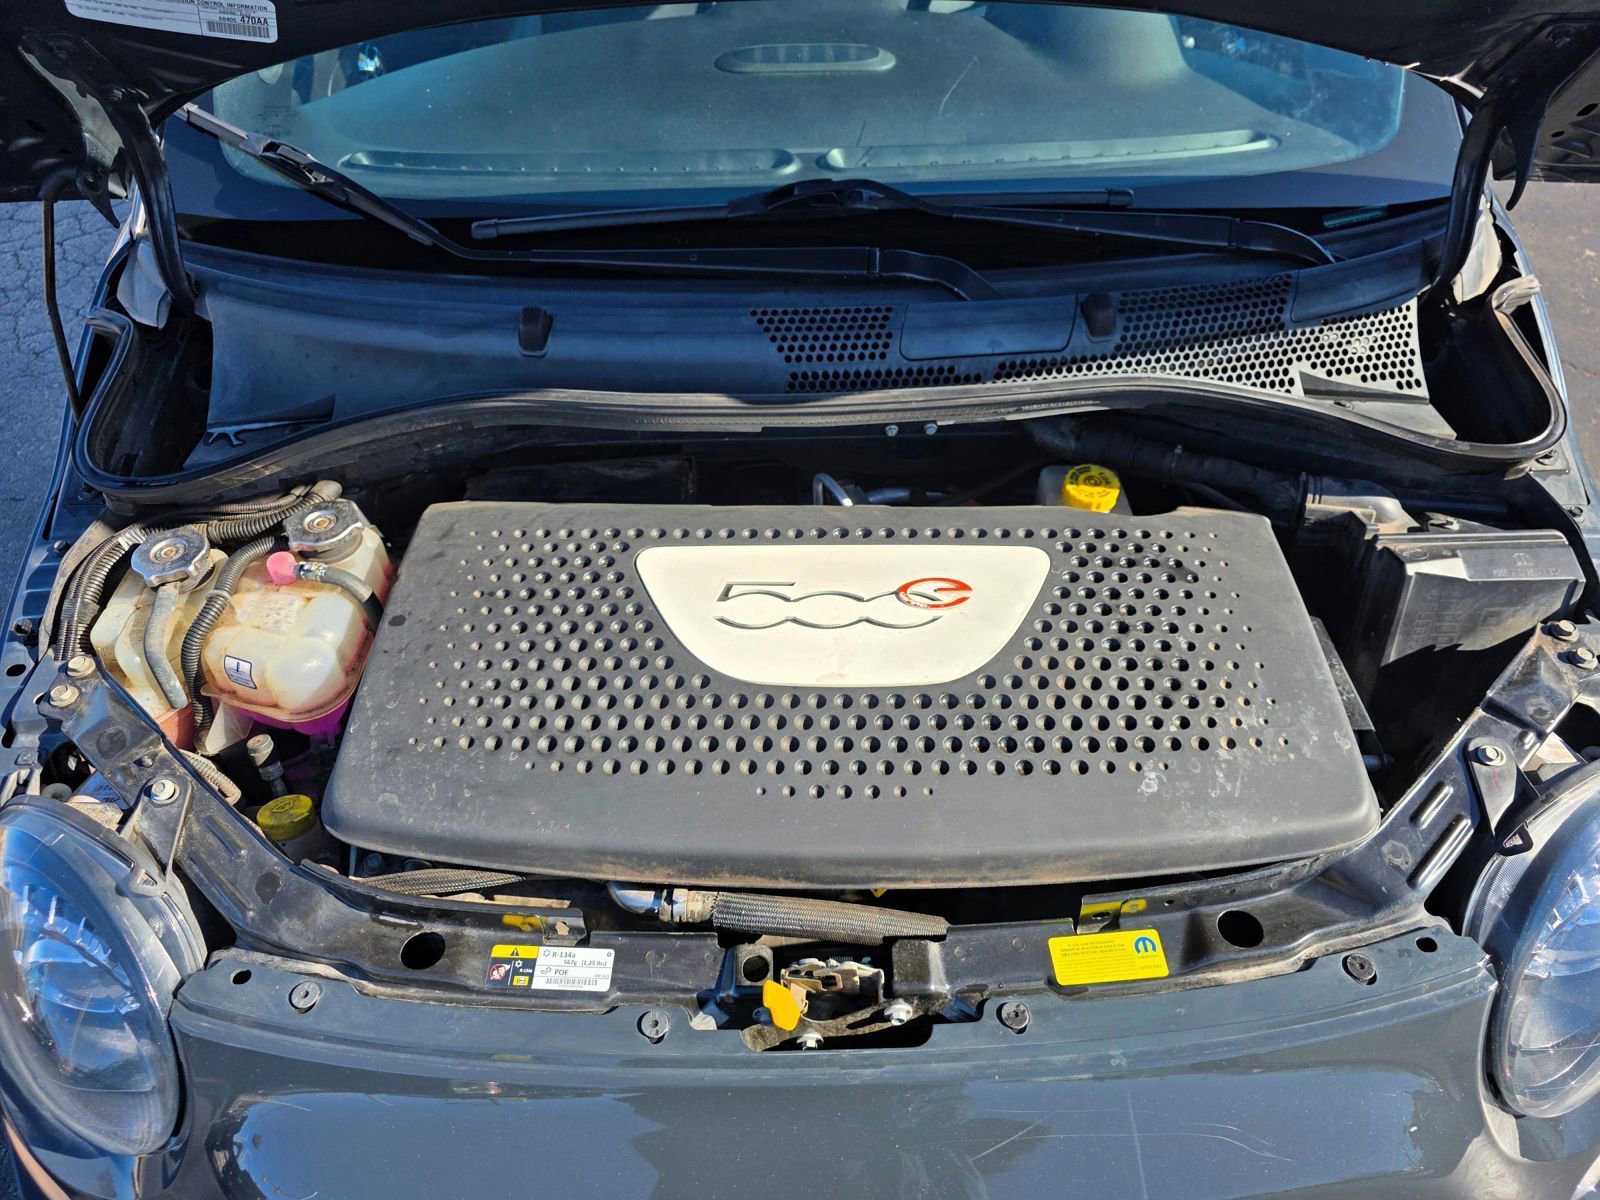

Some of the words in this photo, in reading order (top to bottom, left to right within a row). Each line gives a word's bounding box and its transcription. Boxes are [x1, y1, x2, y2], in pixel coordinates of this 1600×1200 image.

[197, 0, 224, 8] CONTROL
[226, 2, 268, 11] INFORMATION
[240, 15, 269, 26] 470AA
